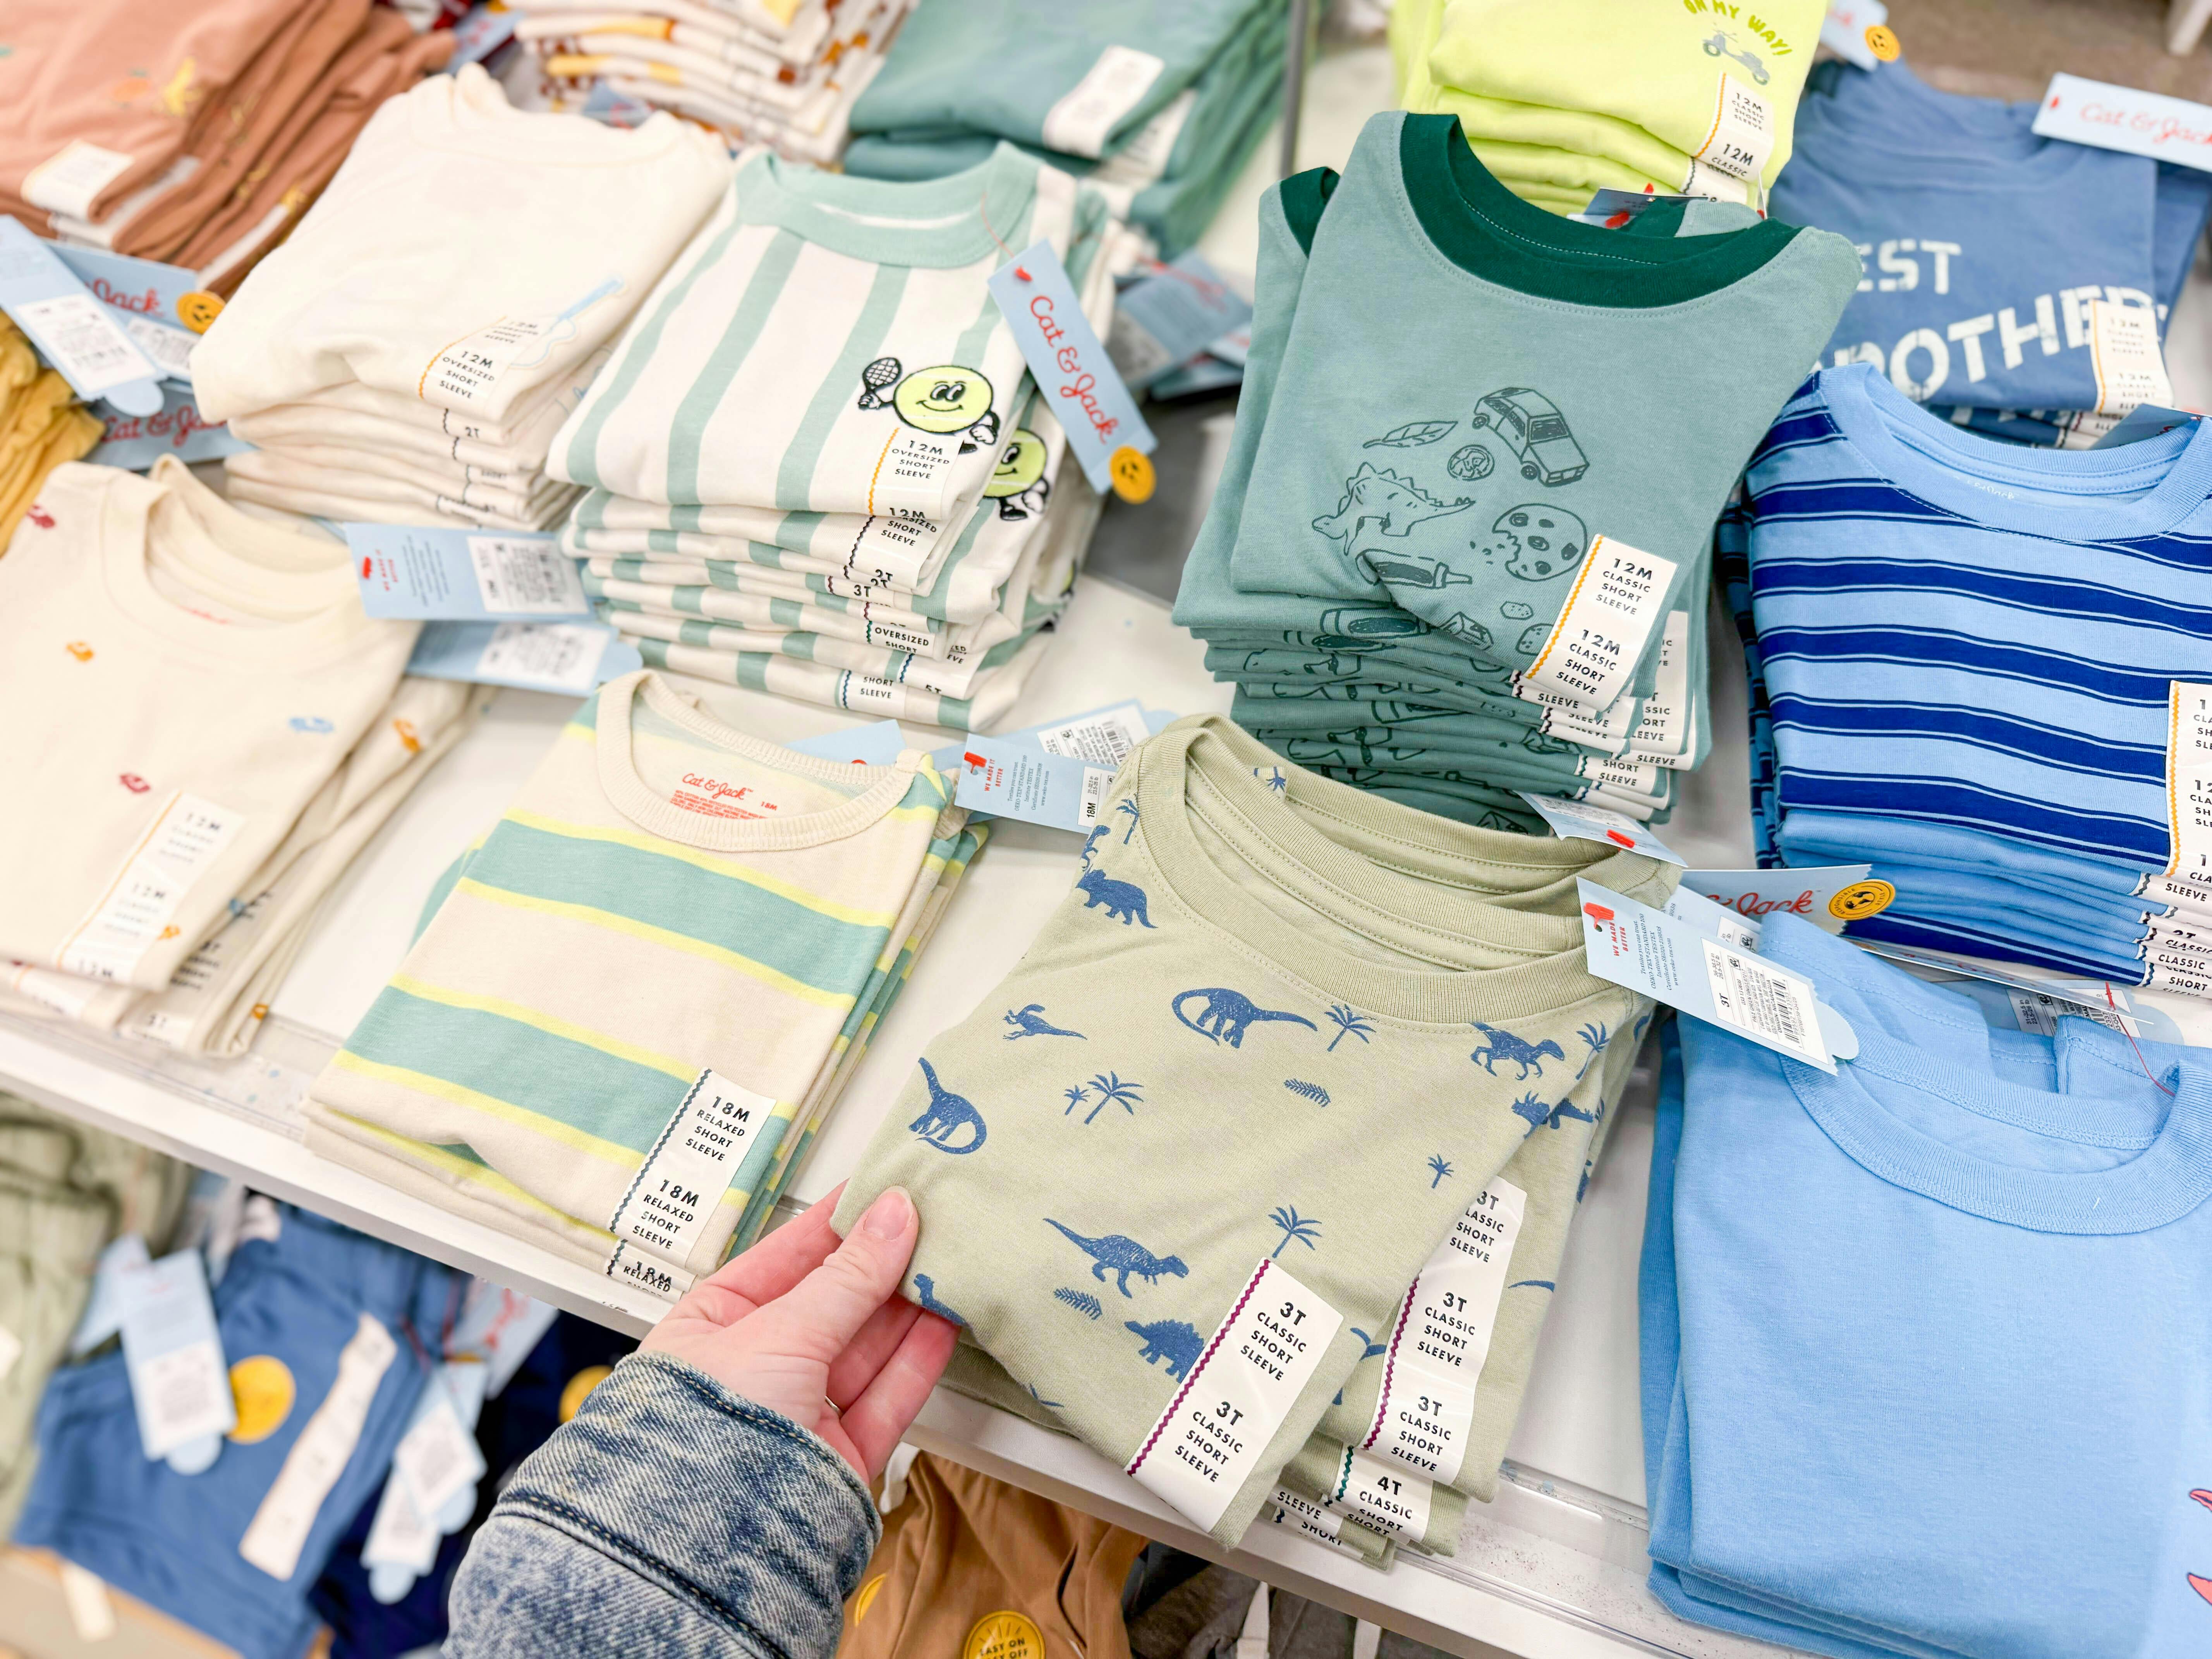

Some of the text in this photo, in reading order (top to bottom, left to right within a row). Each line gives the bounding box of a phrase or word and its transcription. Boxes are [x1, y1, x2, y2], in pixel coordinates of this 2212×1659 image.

[1748, 15, 1792, 55] WAY!
[1732, 100, 1764, 120] CLASSIC
[1736, 93, 1762, 112] 12M
[1734, 115, 1762, 131] SLEEVE
[1735, 108, 1761, 124] SHORT
[2080, 103, 2124, 126] Cat
[1723, 144, 1753, 166] 12M
[1712, 157, 1747, 177] CLASSIC
[442, 356, 495, 382] OVERSIZED
[460, 350, 494, 369] 12M
[1030, 295, 1119, 445] Cat & Jack
[439, 380, 473, 399] SLEEVE
[446, 369, 479, 387] SHORT
[465, 426, 481, 438] 2T
[892, 448, 950, 465] OVERSIZED
[909, 440, 943, 456] 12M
[895, 469, 931, 480] SLEEVE
[900, 459, 934, 470] SHORT
[889, 507, 926, 519] 12M
[881, 529, 915, 547] SLEEVE
[888, 520, 922, 537] SHORT
[875, 569, 893, 580] 2T
[1613, 557, 1652, 580] 12M
[853, 584, 871, 597] 3T
[1602, 582, 1642, 603] SHORT
[1603, 570, 1651, 593] CLASSIC
[1596, 593, 1637, 615] SLEEVE
[874, 626, 929, 646] OVERSIZED
[885, 641, 918, 654] SHORT
[1580, 629, 1620, 656] 12M
[1569, 643, 1617, 671] CLASSIC
[863, 677, 895, 686] SHORT
[1564, 658, 1605, 682] SHORT
[860, 688, 892, 699] SLEEVE
[1556, 671, 1597, 696] SLEEVE
[1538, 692, 1579, 709] SLEEVE
[1602, 759, 1638, 773] SHORT
[1636, 754, 1676, 766] SLEEVE
[682, 773, 703, 787] Cat
[704, 780, 718, 790] &
[984, 783, 991, 791] WE
[995, 768, 1003, 787] BETTER
[1599, 772, 1637, 786] SLEEVE
[761, 801, 777, 811] 18M
[1087, 802, 1096, 818] 18M
[2166, 883, 2207, 902] SLEEVE
[1609, 922, 1620, 956] WE MADE
[1620, 926, 1628, 951] BETTER
[1641, 924, 1650, 955] STANDARD
[1650, 931, 1658, 954] TESTEX
[1668, 938, 1678, 986] www.oeko-tex.com
[2159, 954, 2205, 969] CLASSIC
[1664, 963, 1672, 990] Certificate
[2169, 977, 2208, 991] SHORT
[1719, 993, 1729, 1008] 3T
[1766, 980, 1777, 1012] NICARAGUA
[712, 1096, 750, 1123] 18M
[697, 1109, 745, 1137] RELAXED
[694, 1125, 733, 1148] SHORT
[685, 1139, 725, 1162] SLEEVE
[659, 1179, 699, 1208] 18M
[1476, 1190, 1499, 1211] 3T
[643, 1194, 694, 1223] RELAXED
[641, 1211, 681, 1234] SHORT
[1465, 1209, 1504, 1234] LASSIC
[632, 1225, 673, 1250] SLEEVE
[1456, 1221, 1495, 1247] SHORT
[1449, 1237, 1490, 1264] SLEEVE
[623, 1266, 671, 1293] RELAXED
[1280, 1301, 1307, 1326] 3T
[1443, 1292, 1467, 1313] 3T
[1257, 1312, 1307, 1352] CLASSIC
[1424, 1307, 1475, 1336] CLASSIC
[1251, 1330, 1294, 1364] SHORT
[1424, 1325, 1468, 1350] SHORT
[1240, 1345, 1284, 1381] SLEEVE
[1417, 1341, 1462, 1367] SLEEVE
[1216, 1401, 1244, 1427] 3T
[1417, 1396, 1443, 1417] 3T
[1192, 1411, 1243, 1453] CLASSIC
[1399, 1411, 1451, 1441] CLASSIC
[1186, 1430, 1229, 1466] SHORT
[1399, 1431, 1443, 1456] SHORT
[1175, 1445, 1219, 1483] SLEEVE
[1391, 1446, 1437, 1472] SLEEVE
[1377, 1475, 1403, 1496] 4T
[1277, 1491, 1322, 1520] SLEEVE
[1359, 1491, 1413, 1520] CLASSIC
[1348, 1513, 1390, 1536] SHORT
[1358, 1509, 1403, 1532] SHORT
[1010, 1637, 1025, 1647] ON
